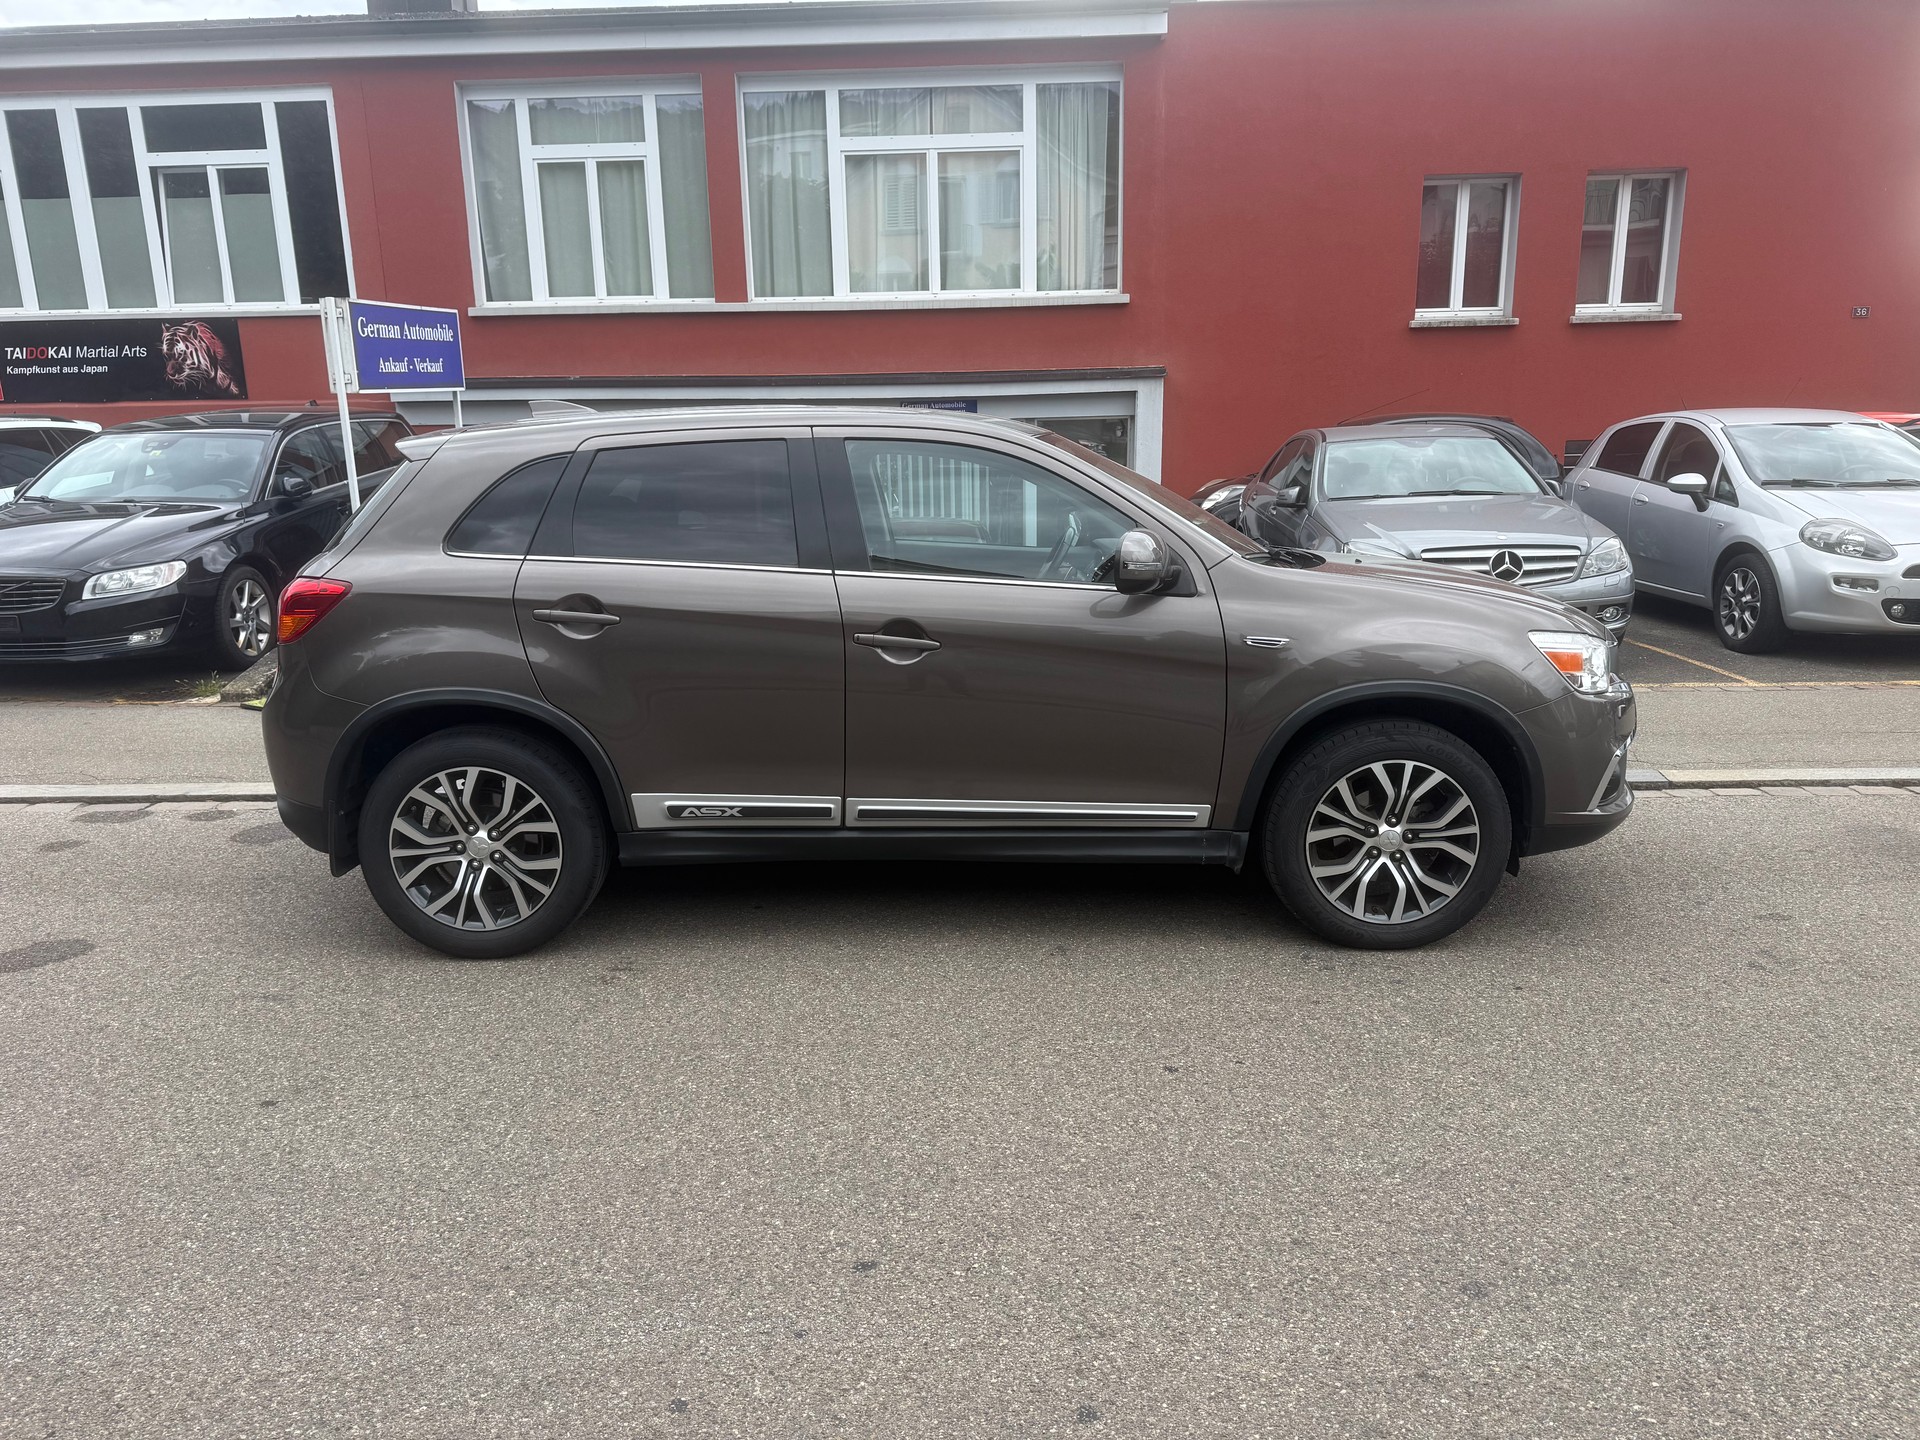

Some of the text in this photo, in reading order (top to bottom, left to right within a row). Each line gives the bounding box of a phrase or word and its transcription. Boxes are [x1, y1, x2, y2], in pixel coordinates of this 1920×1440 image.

[1856, 308, 1867, 316] 36
[358, 317, 454, 341] German Automobile
[5, 345, 147, 359] TAIDOKAI Martial Arts
[6, 364, 108, 375] Kampfkunst aus Japan
[379, 357, 408, 373] Ankauf
[413, 357, 444, 373] Verkauf
[929, 401, 967, 409] Automobile
[680, 807, 743, 817] ASX
